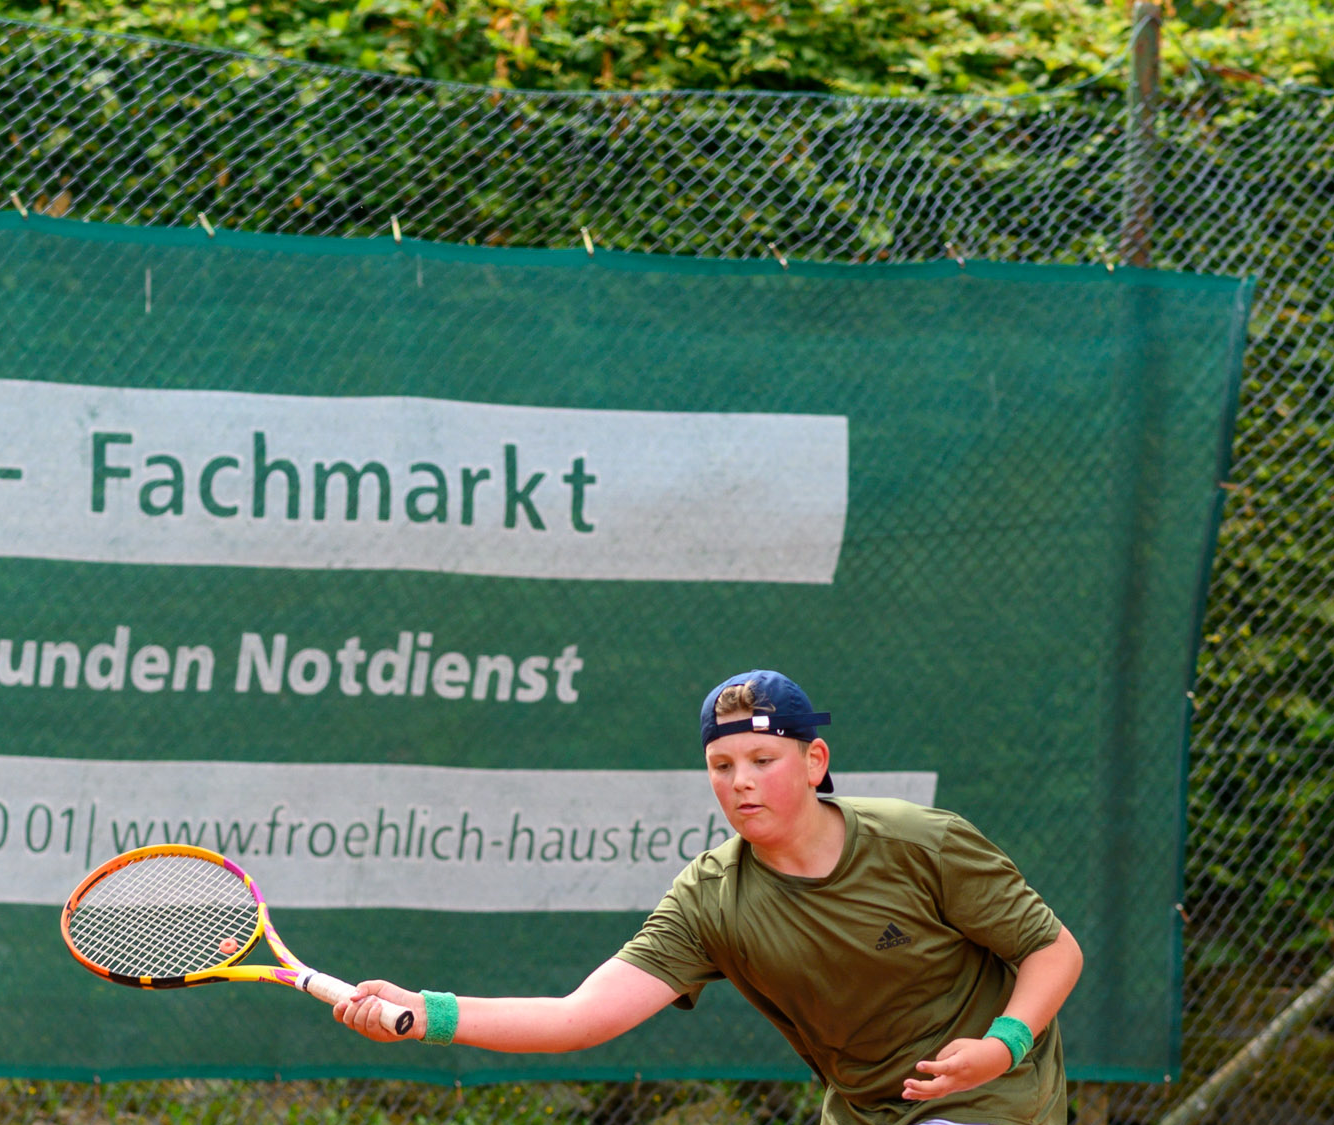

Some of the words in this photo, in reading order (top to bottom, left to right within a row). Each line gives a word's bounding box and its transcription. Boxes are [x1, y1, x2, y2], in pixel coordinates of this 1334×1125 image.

[91, 430, 597, 533] Fachmarkt
[234, 630, 584, 703] Notdienst
[111, 804, 729, 862] www.froehlich-haustech
[875, 935, 912, 951] adidas
